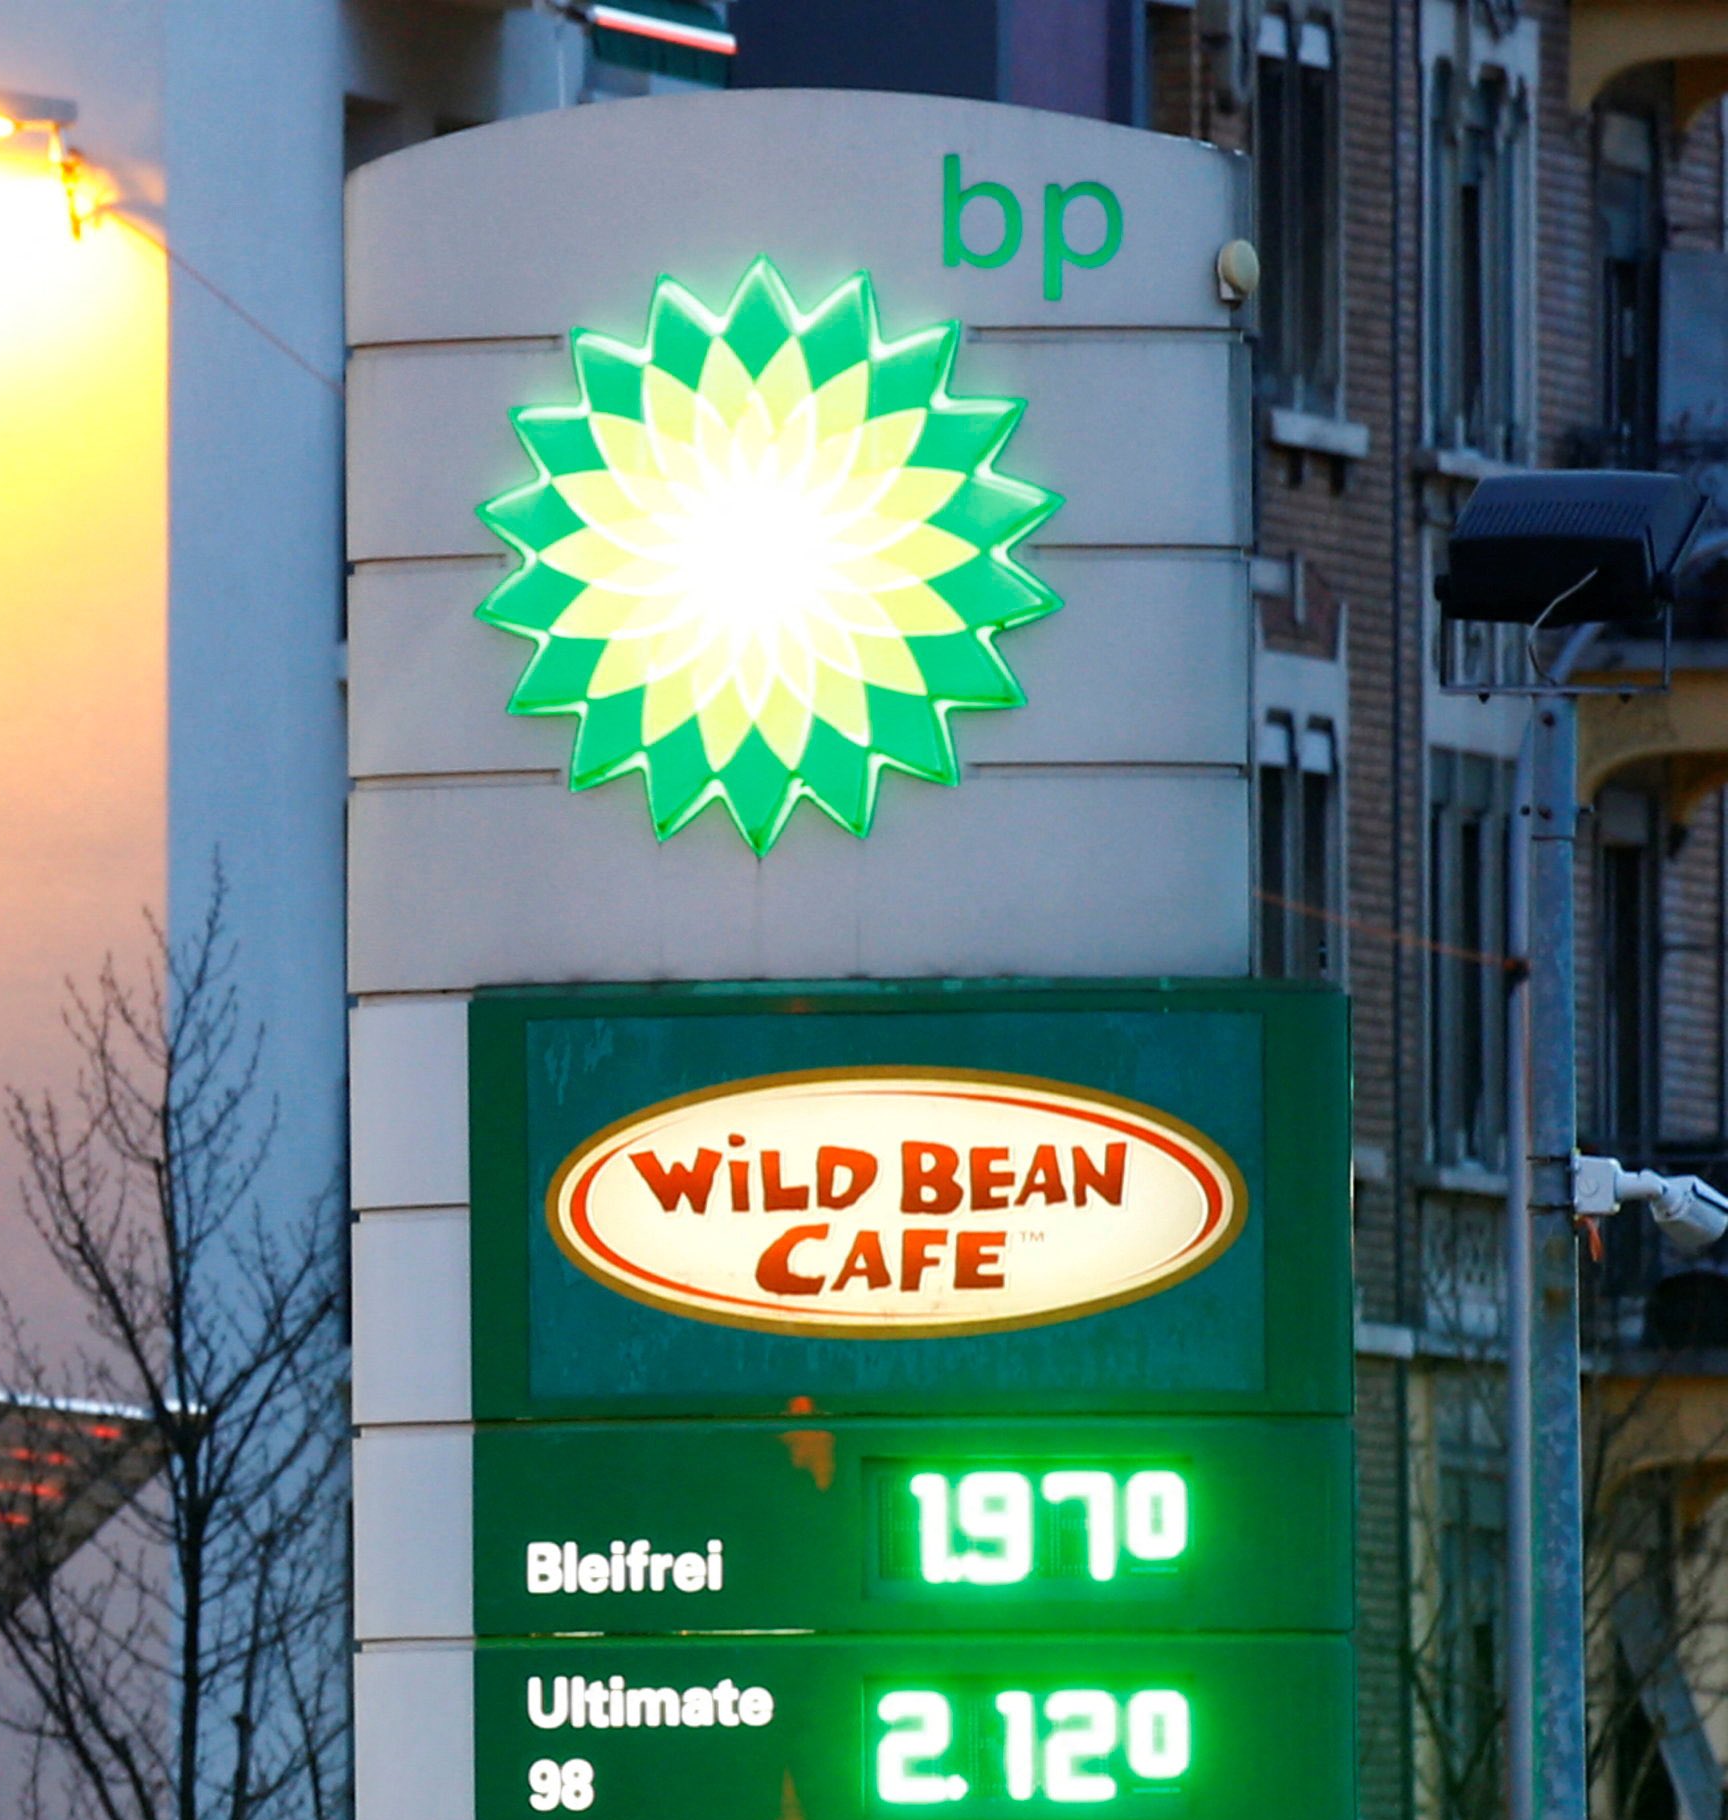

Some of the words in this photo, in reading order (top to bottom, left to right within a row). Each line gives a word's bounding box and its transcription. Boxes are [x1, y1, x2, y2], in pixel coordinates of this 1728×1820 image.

[943, 153, 1123, 301] bp
[900, 1141, 1128, 1215] BEAN
[755, 1223, 1007, 1296] CAFE
[526, 1539, 723, 1594] Bleifrei
[526, 1675, 775, 1729] Ultimate
[528, 1757, 594, 1812] 98
